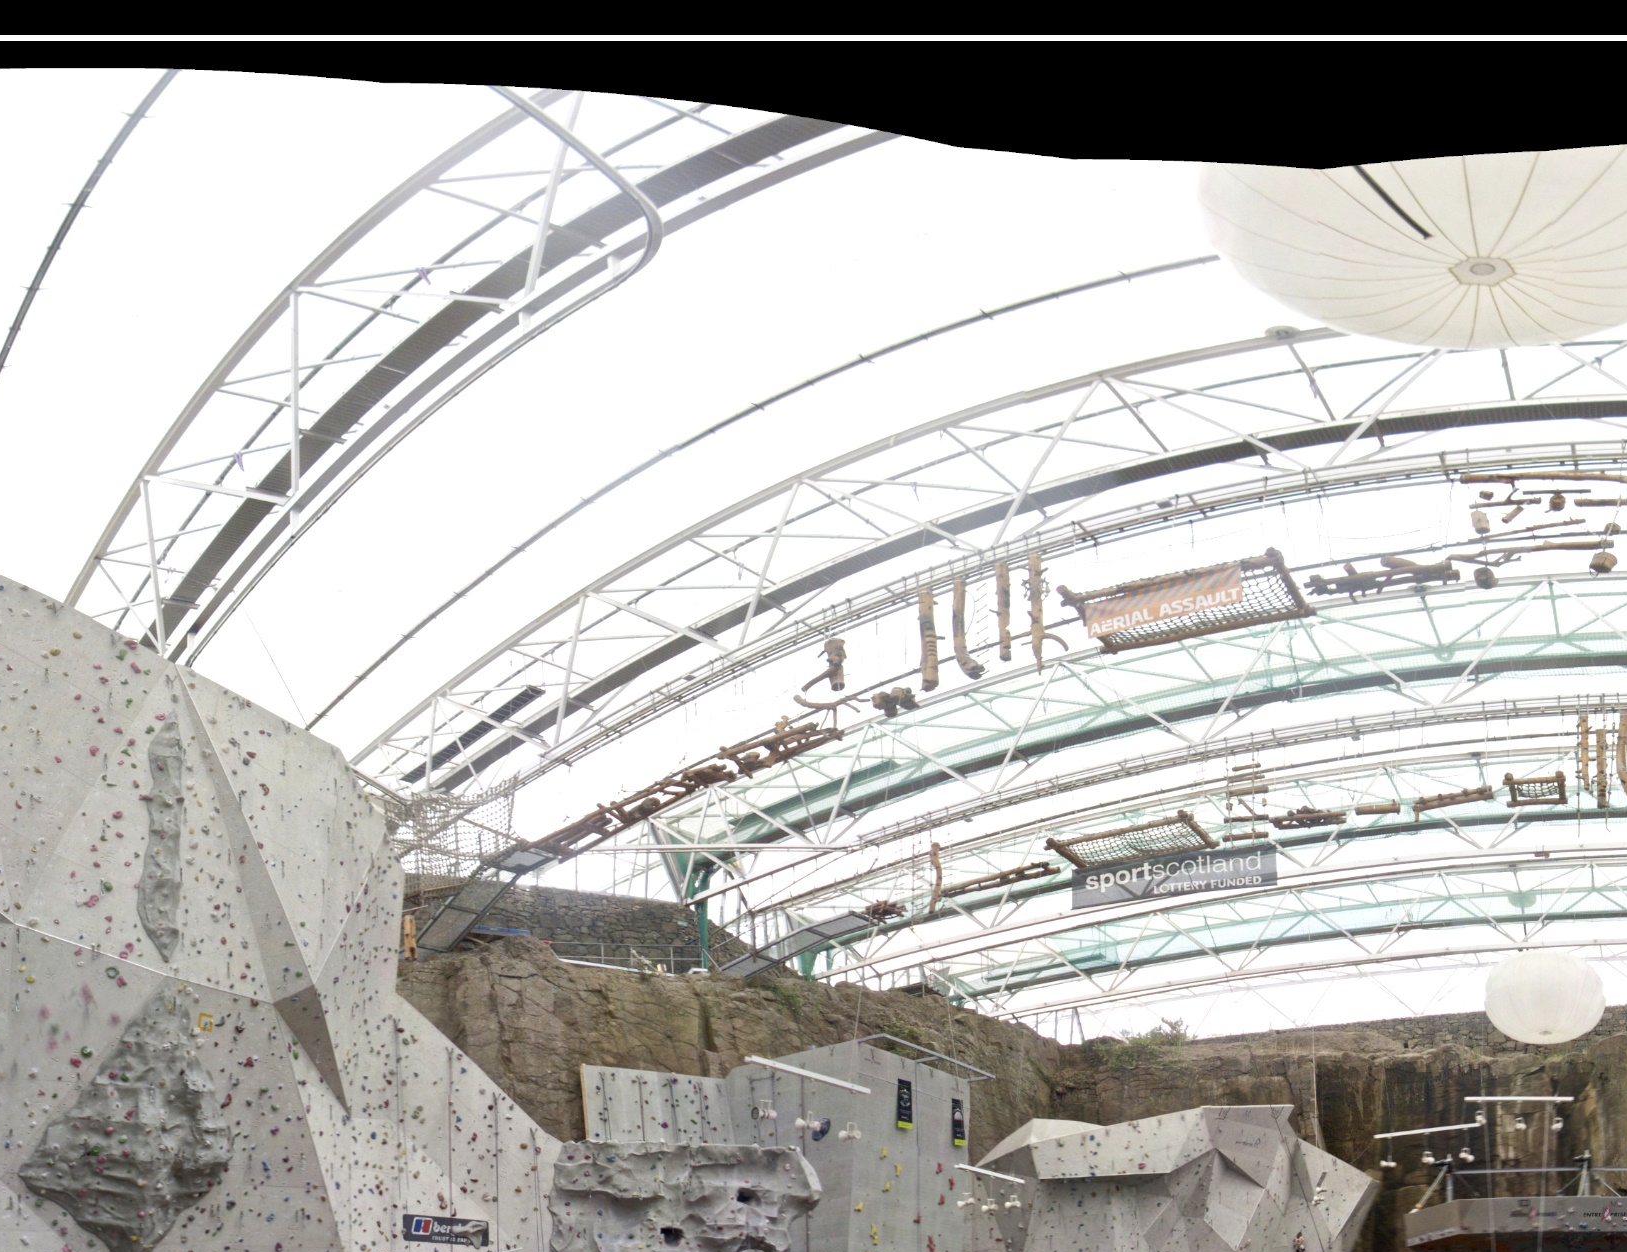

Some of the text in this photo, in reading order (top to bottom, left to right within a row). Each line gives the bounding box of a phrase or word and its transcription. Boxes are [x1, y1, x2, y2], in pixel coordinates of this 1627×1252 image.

[1090, 588, 1240, 636] AERIAL ASSAULT
[1085, 851, 1262, 893] sportscotland
[1153, 875, 1262, 895] LOTTERY FUNDED
